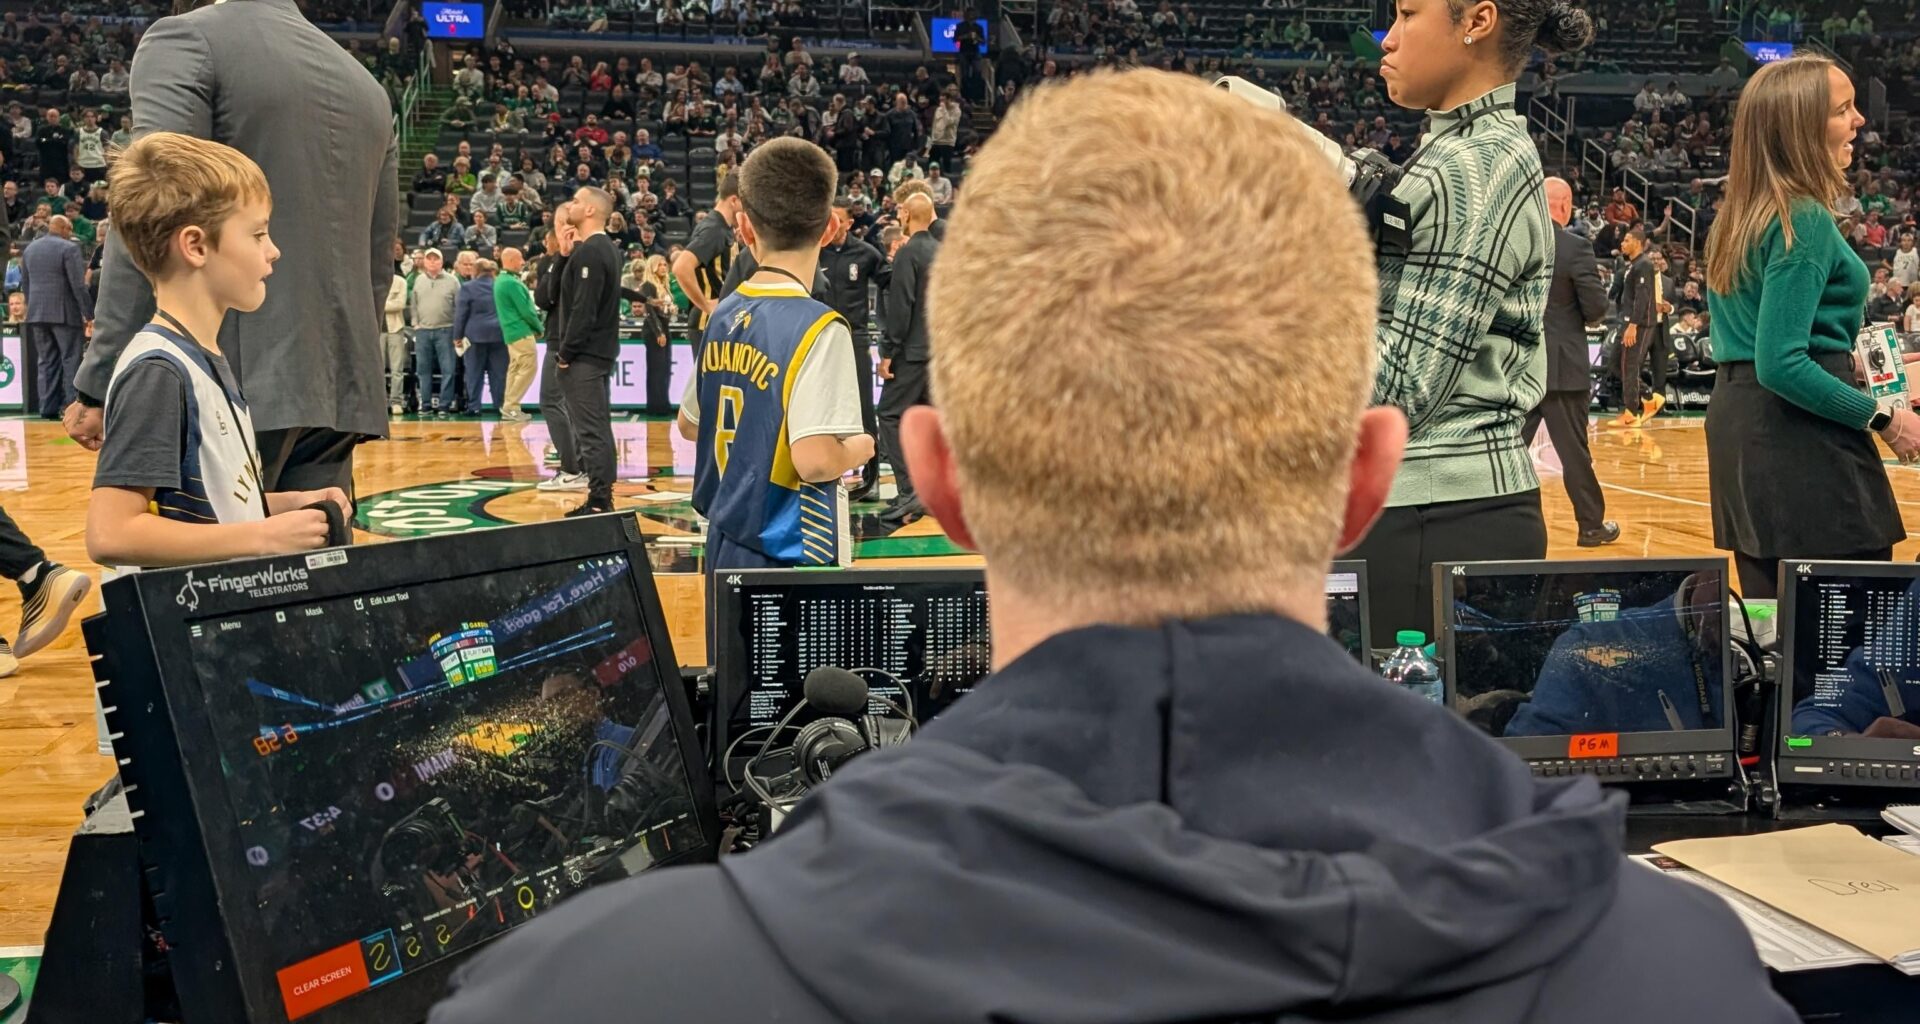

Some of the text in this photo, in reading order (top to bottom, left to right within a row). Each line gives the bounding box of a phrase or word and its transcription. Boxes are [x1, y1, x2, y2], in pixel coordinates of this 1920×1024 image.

[435, 14, 470, 24] ULTRA
[1680, 391, 1711, 405] jetBlue
[1451, 566, 1466, 576] 4K
[1796, 564, 1812, 574] 4K
[207, 564, 309, 593] FingerWorks
[726, 574, 742, 585] 4K
[248, 582, 309, 599] TELESTRATORS
[370, 591, 410, 606] Edit Last Tool
[305, 606, 324, 617] Mask
[220, 621, 242, 632] Menu
[1578, 737, 1611, 751] PGM
[293, 966, 352, 997] CLEAR SCREEN
